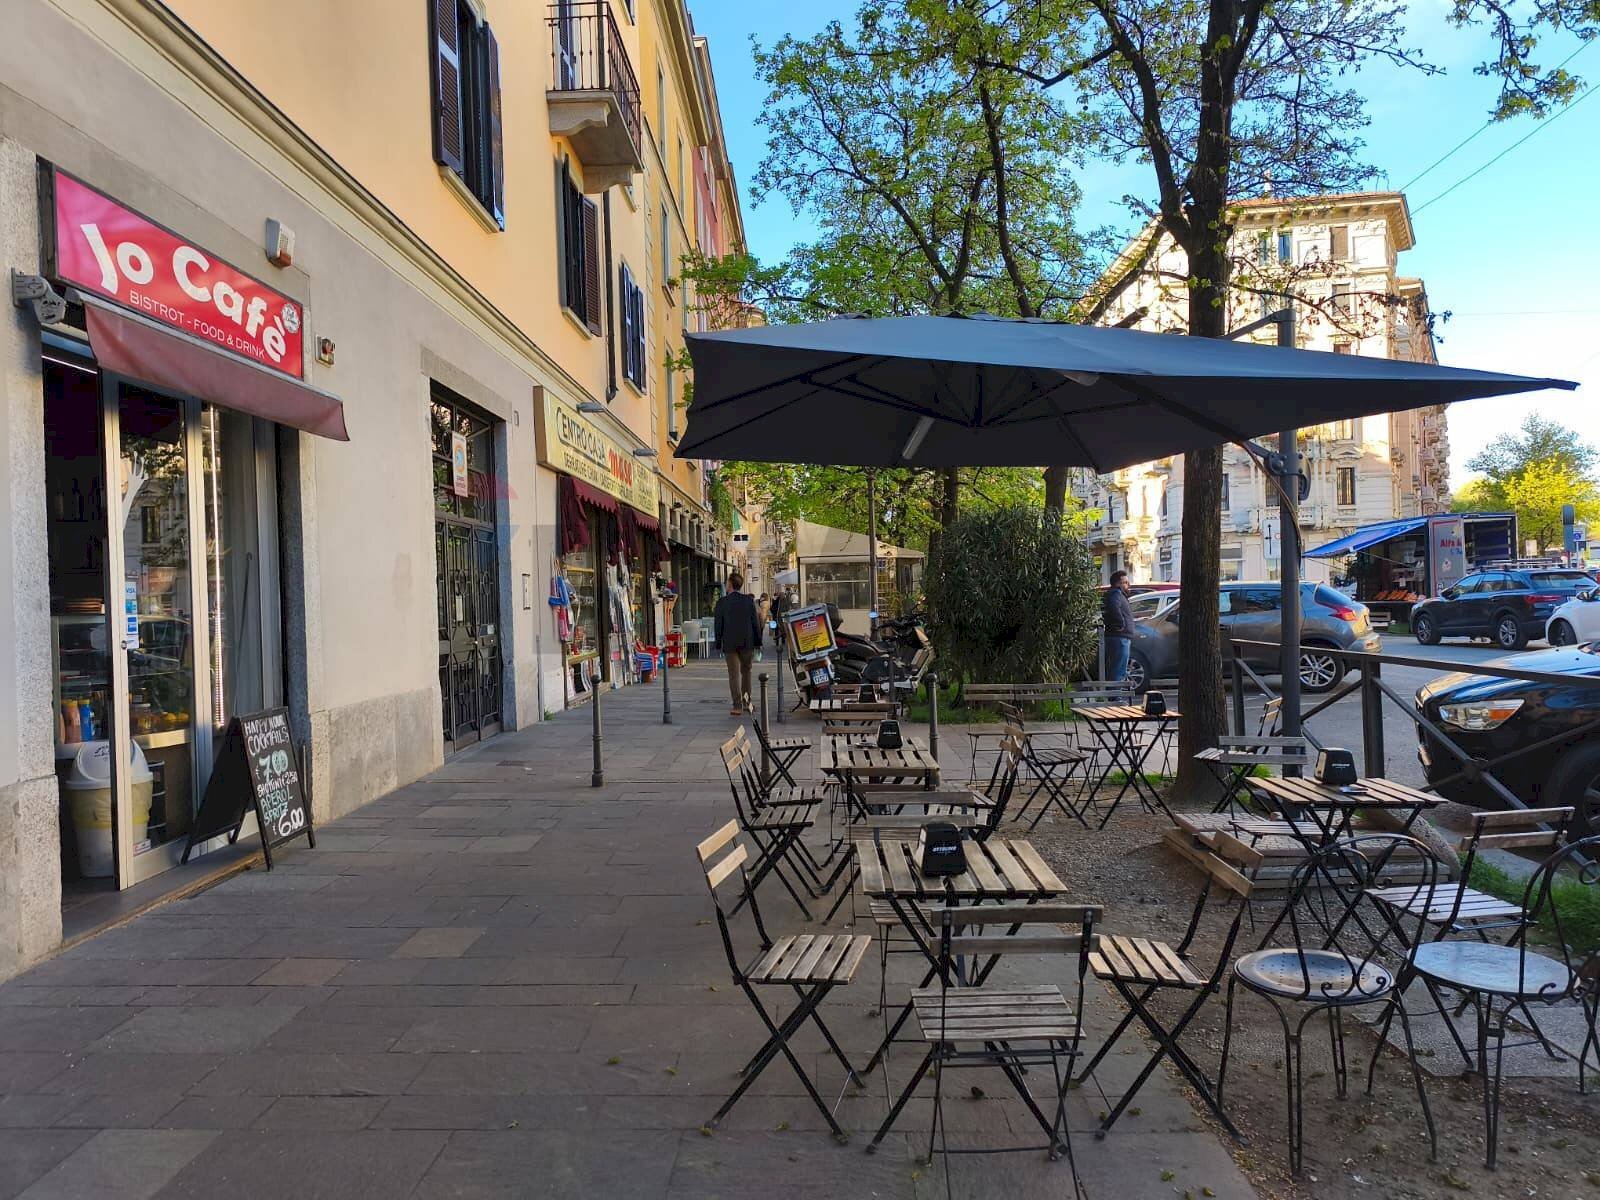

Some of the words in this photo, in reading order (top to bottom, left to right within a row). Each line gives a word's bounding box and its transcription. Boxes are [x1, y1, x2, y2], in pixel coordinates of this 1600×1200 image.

[80, 223, 154, 295] Jo
[129, 290, 185, 324] BISTROT
[194, 318, 225, 342] FOOD
[226, 334, 234, 346] &
[235, 337, 265, 359] DRINK
[556, 406, 587, 451] CENTRO
[244, 718, 267, 737] HAPPY
[247, 726, 290, 757] COCKTAILS
[260, 784, 293, 811] APEROL
[263, 801, 289, 827] SPRITZ
